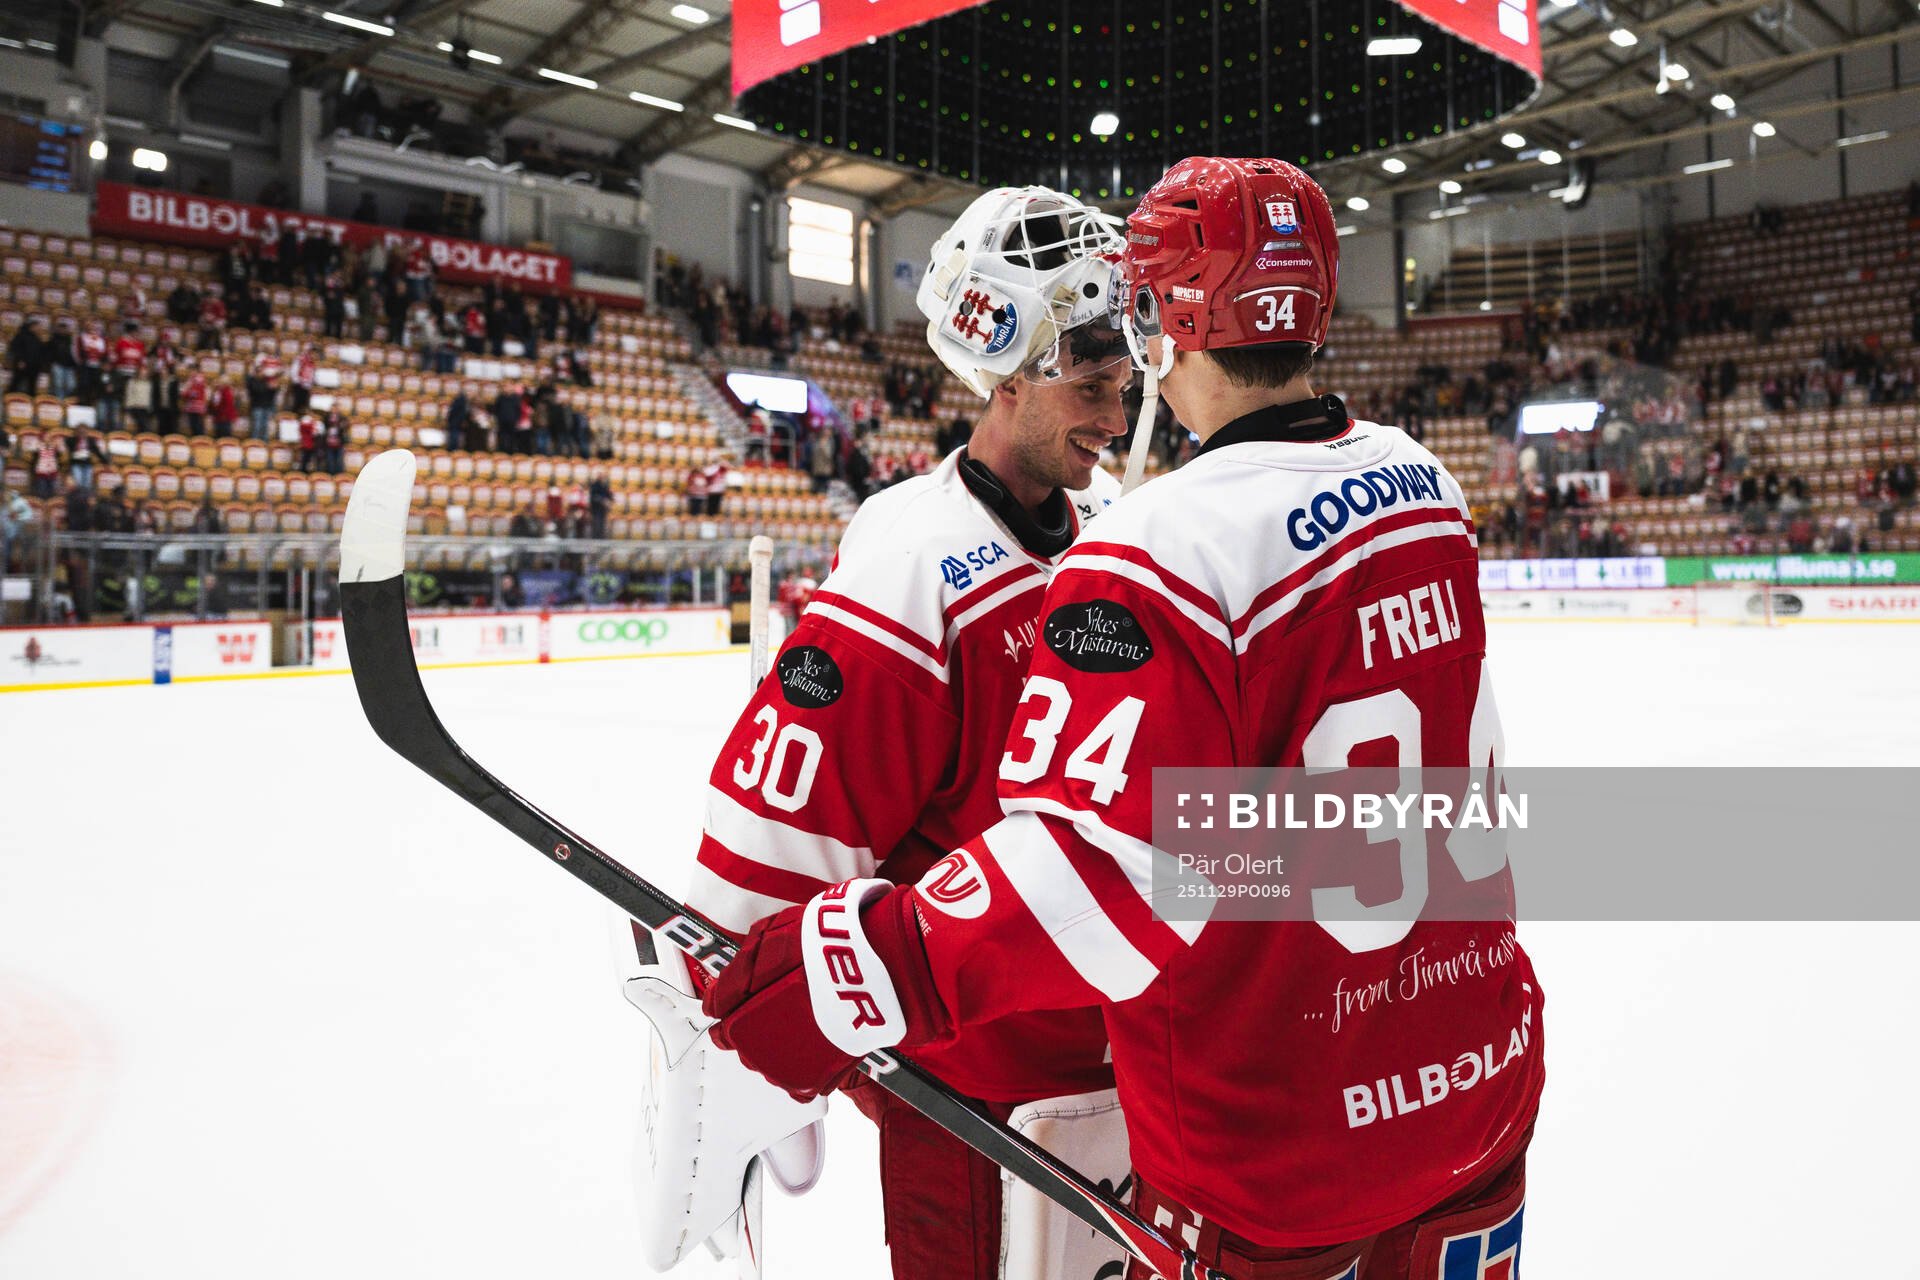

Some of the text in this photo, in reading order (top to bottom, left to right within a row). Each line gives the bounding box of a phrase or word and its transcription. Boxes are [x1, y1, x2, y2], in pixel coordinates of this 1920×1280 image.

[1265, 258, 1313, 268] consembly
[1255, 294, 1296, 332] 34
[1286, 463, 1443, 552] GOODWAY
[966, 540, 1010, 572] SCA
[578, 618, 669, 646] coop
[1357, 578, 1462, 671] FREIJ
[733, 703, 824, 813] 30
[999, 675, 1146, 806] 34
[1331, 977, 1394, 1034] from
[1399, 939, 1486, 1001] Timrå
